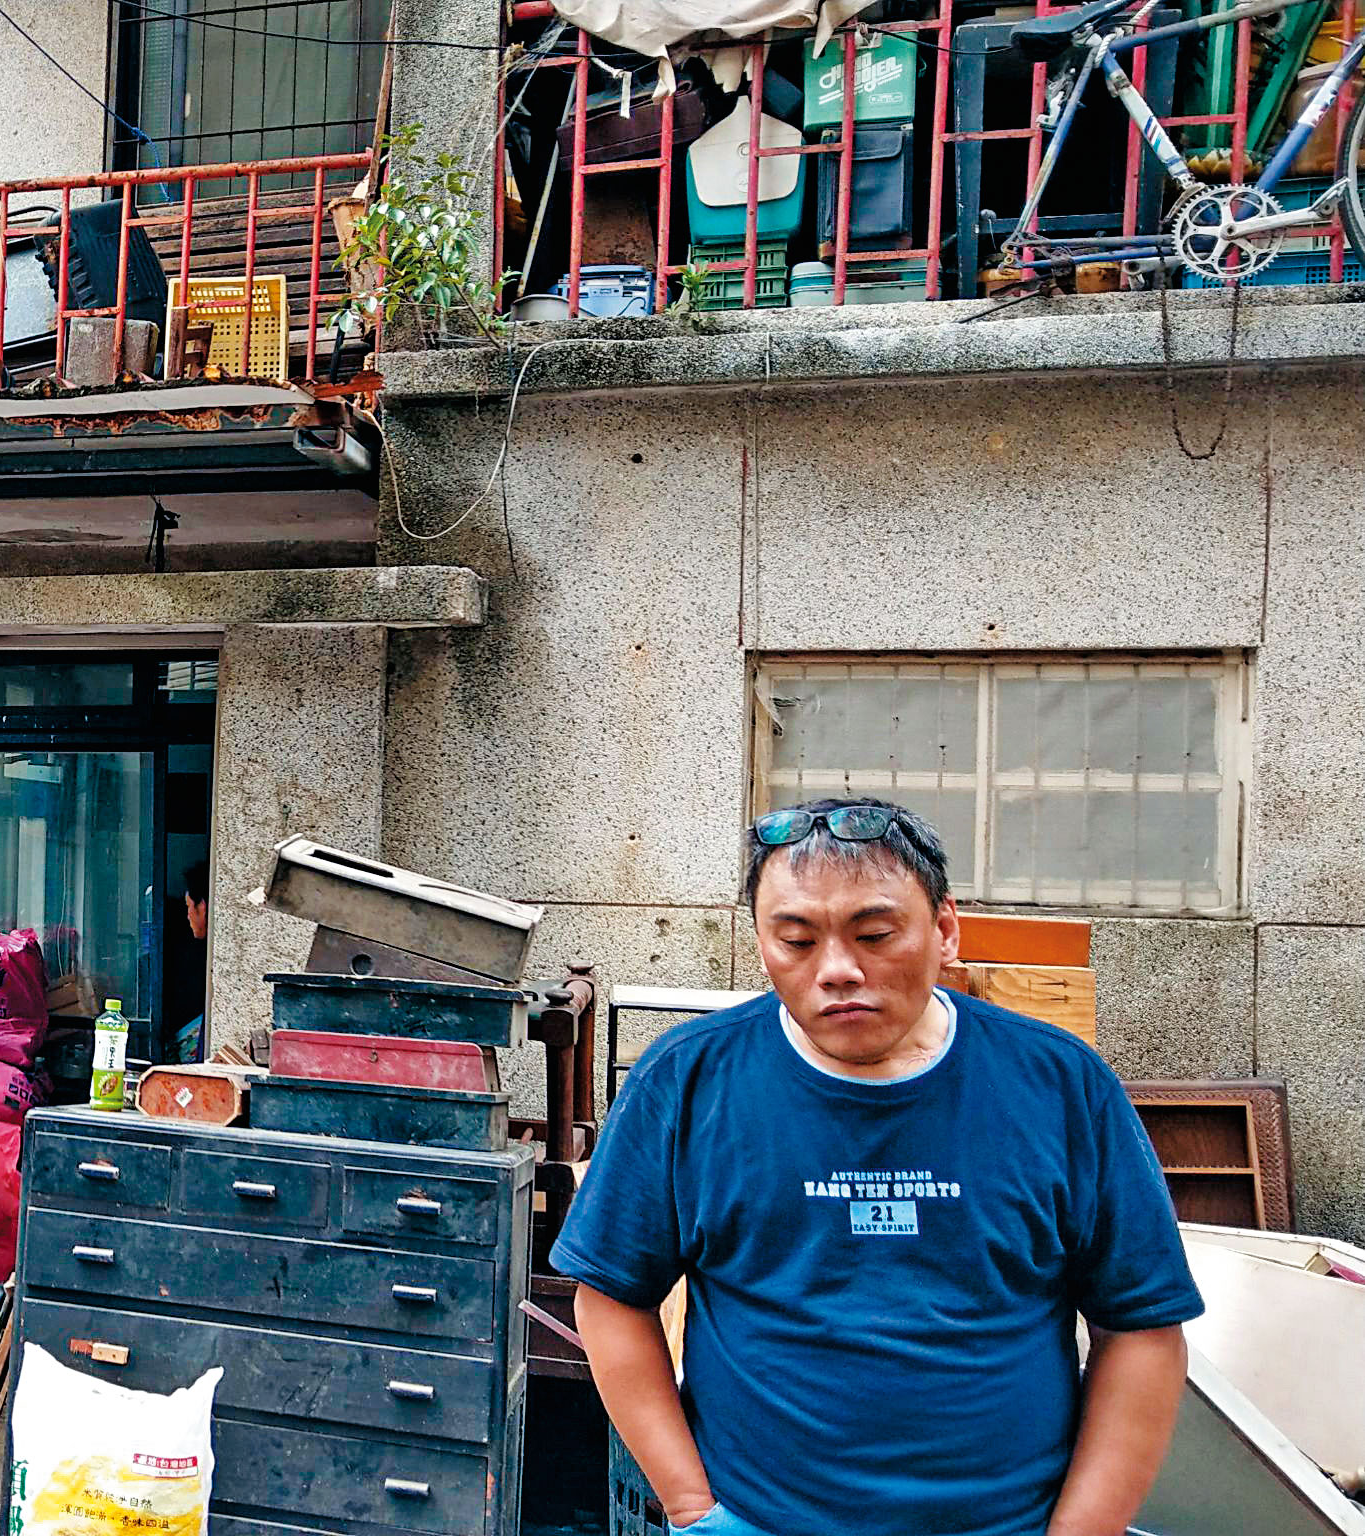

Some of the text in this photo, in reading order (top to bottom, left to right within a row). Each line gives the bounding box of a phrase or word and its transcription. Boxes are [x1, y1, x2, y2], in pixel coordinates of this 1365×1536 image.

[831, 1171, 933, 1181] AUTHENTIC BRAND
[856, 1183, 889, 1198] TEN
[893, 1182, 961, 1198] SPORTS
[871, 1205, 894, 1222] 21
[853, 1223, 915, 1232] EASY SPIRIT
